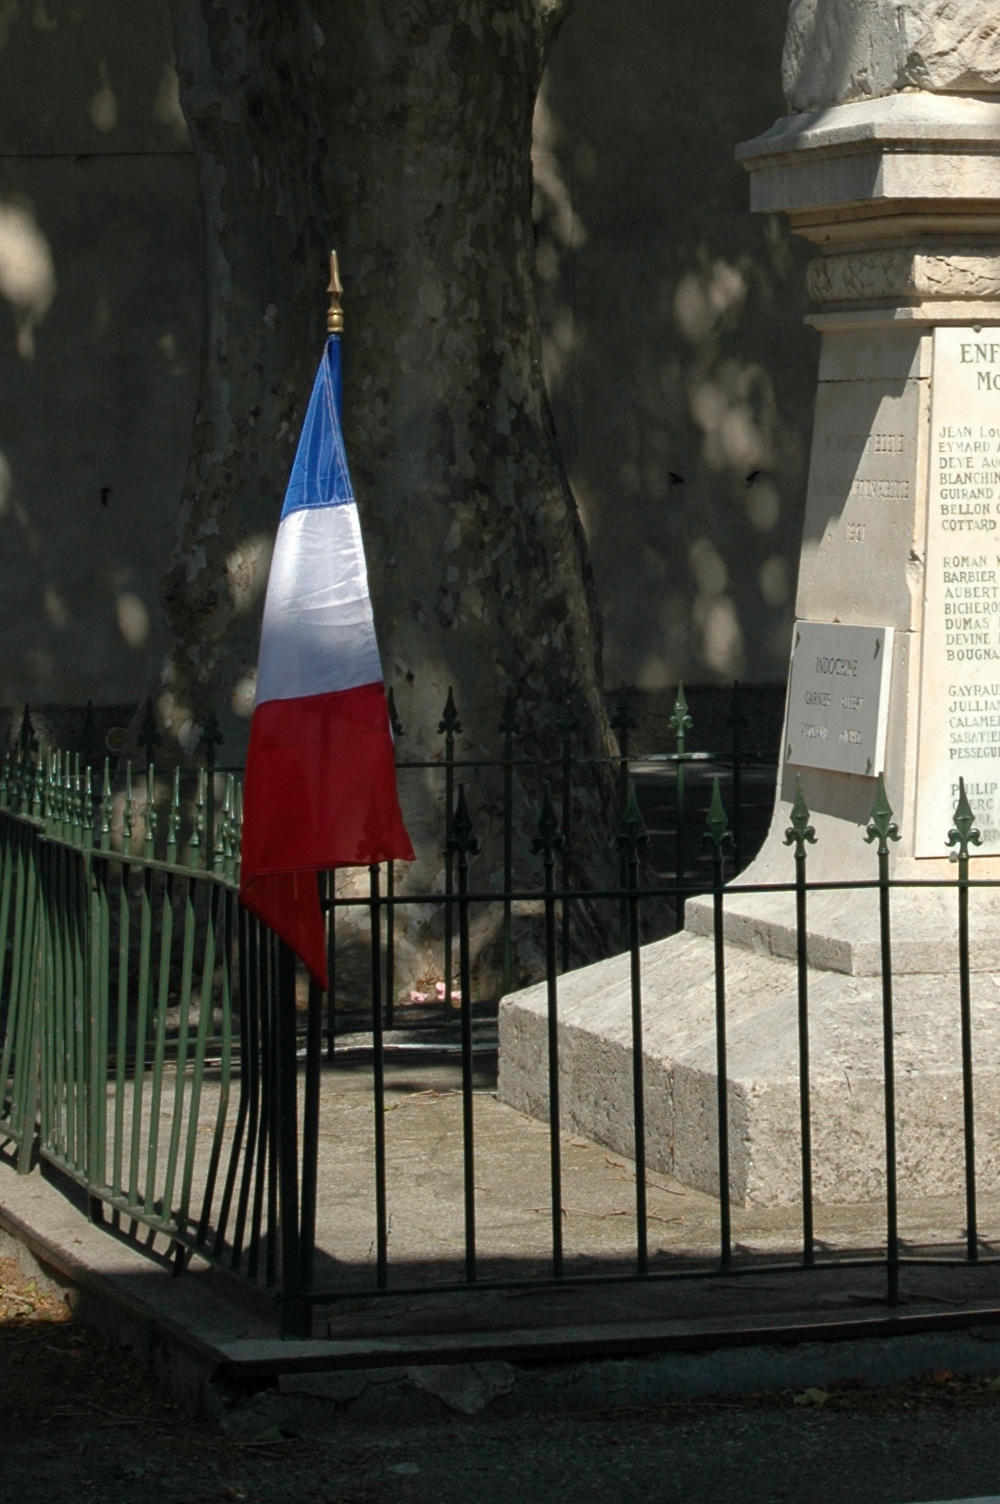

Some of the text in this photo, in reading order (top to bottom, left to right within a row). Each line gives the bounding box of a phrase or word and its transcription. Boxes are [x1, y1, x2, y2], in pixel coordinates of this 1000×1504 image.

[939, 427, 971, 437] JEAN
[939, 442, 989, 452] EYMARD
[940, 488, 993, 500] GUIRAND
[941, 504, 990, 515] BELLON
[942, 520, 996, 531] COTTARD
[944, 556, 986, 567] ROMAN
[944, 571, 996, 584] BARBIER
[945, 587, 998, 598] AUBERT
[945, 618, 989, 630] DUMAS
[946, 633, 990, 645] DEVINE
[953, 798, 993, 810] CERC
